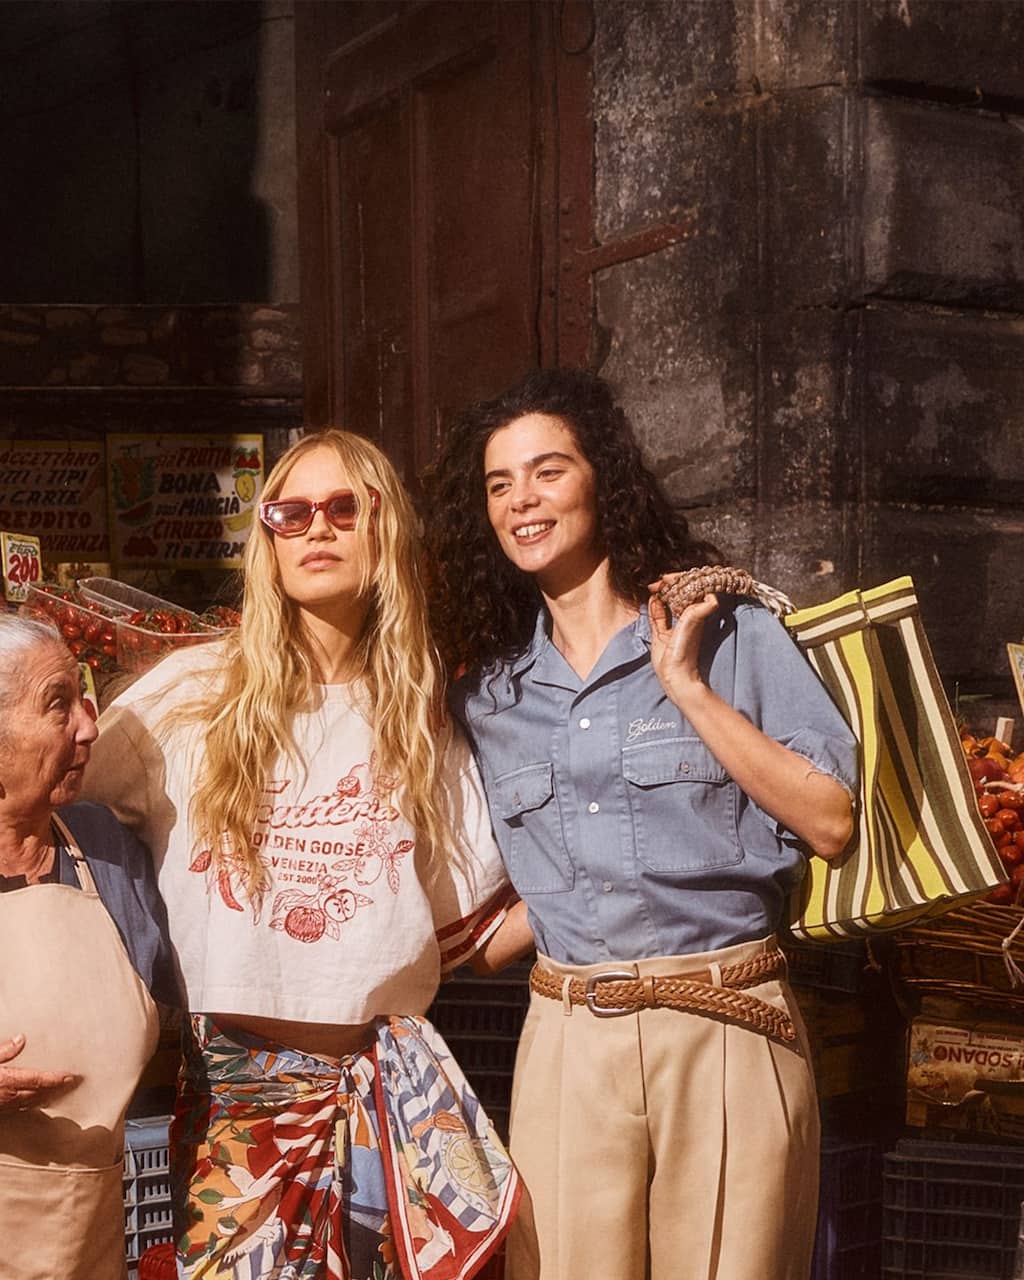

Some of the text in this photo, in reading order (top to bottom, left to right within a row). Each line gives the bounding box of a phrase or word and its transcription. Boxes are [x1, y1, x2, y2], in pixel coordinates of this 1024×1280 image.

[176, 447, 232, 468] FRUTTA
[158, 471, 221, 494] BONA
[625, 718, 677, 742] Golden
[252, 832, 366, 857] OLDEN GOOSE
[271, 855, 328, 874] VENEZIA
